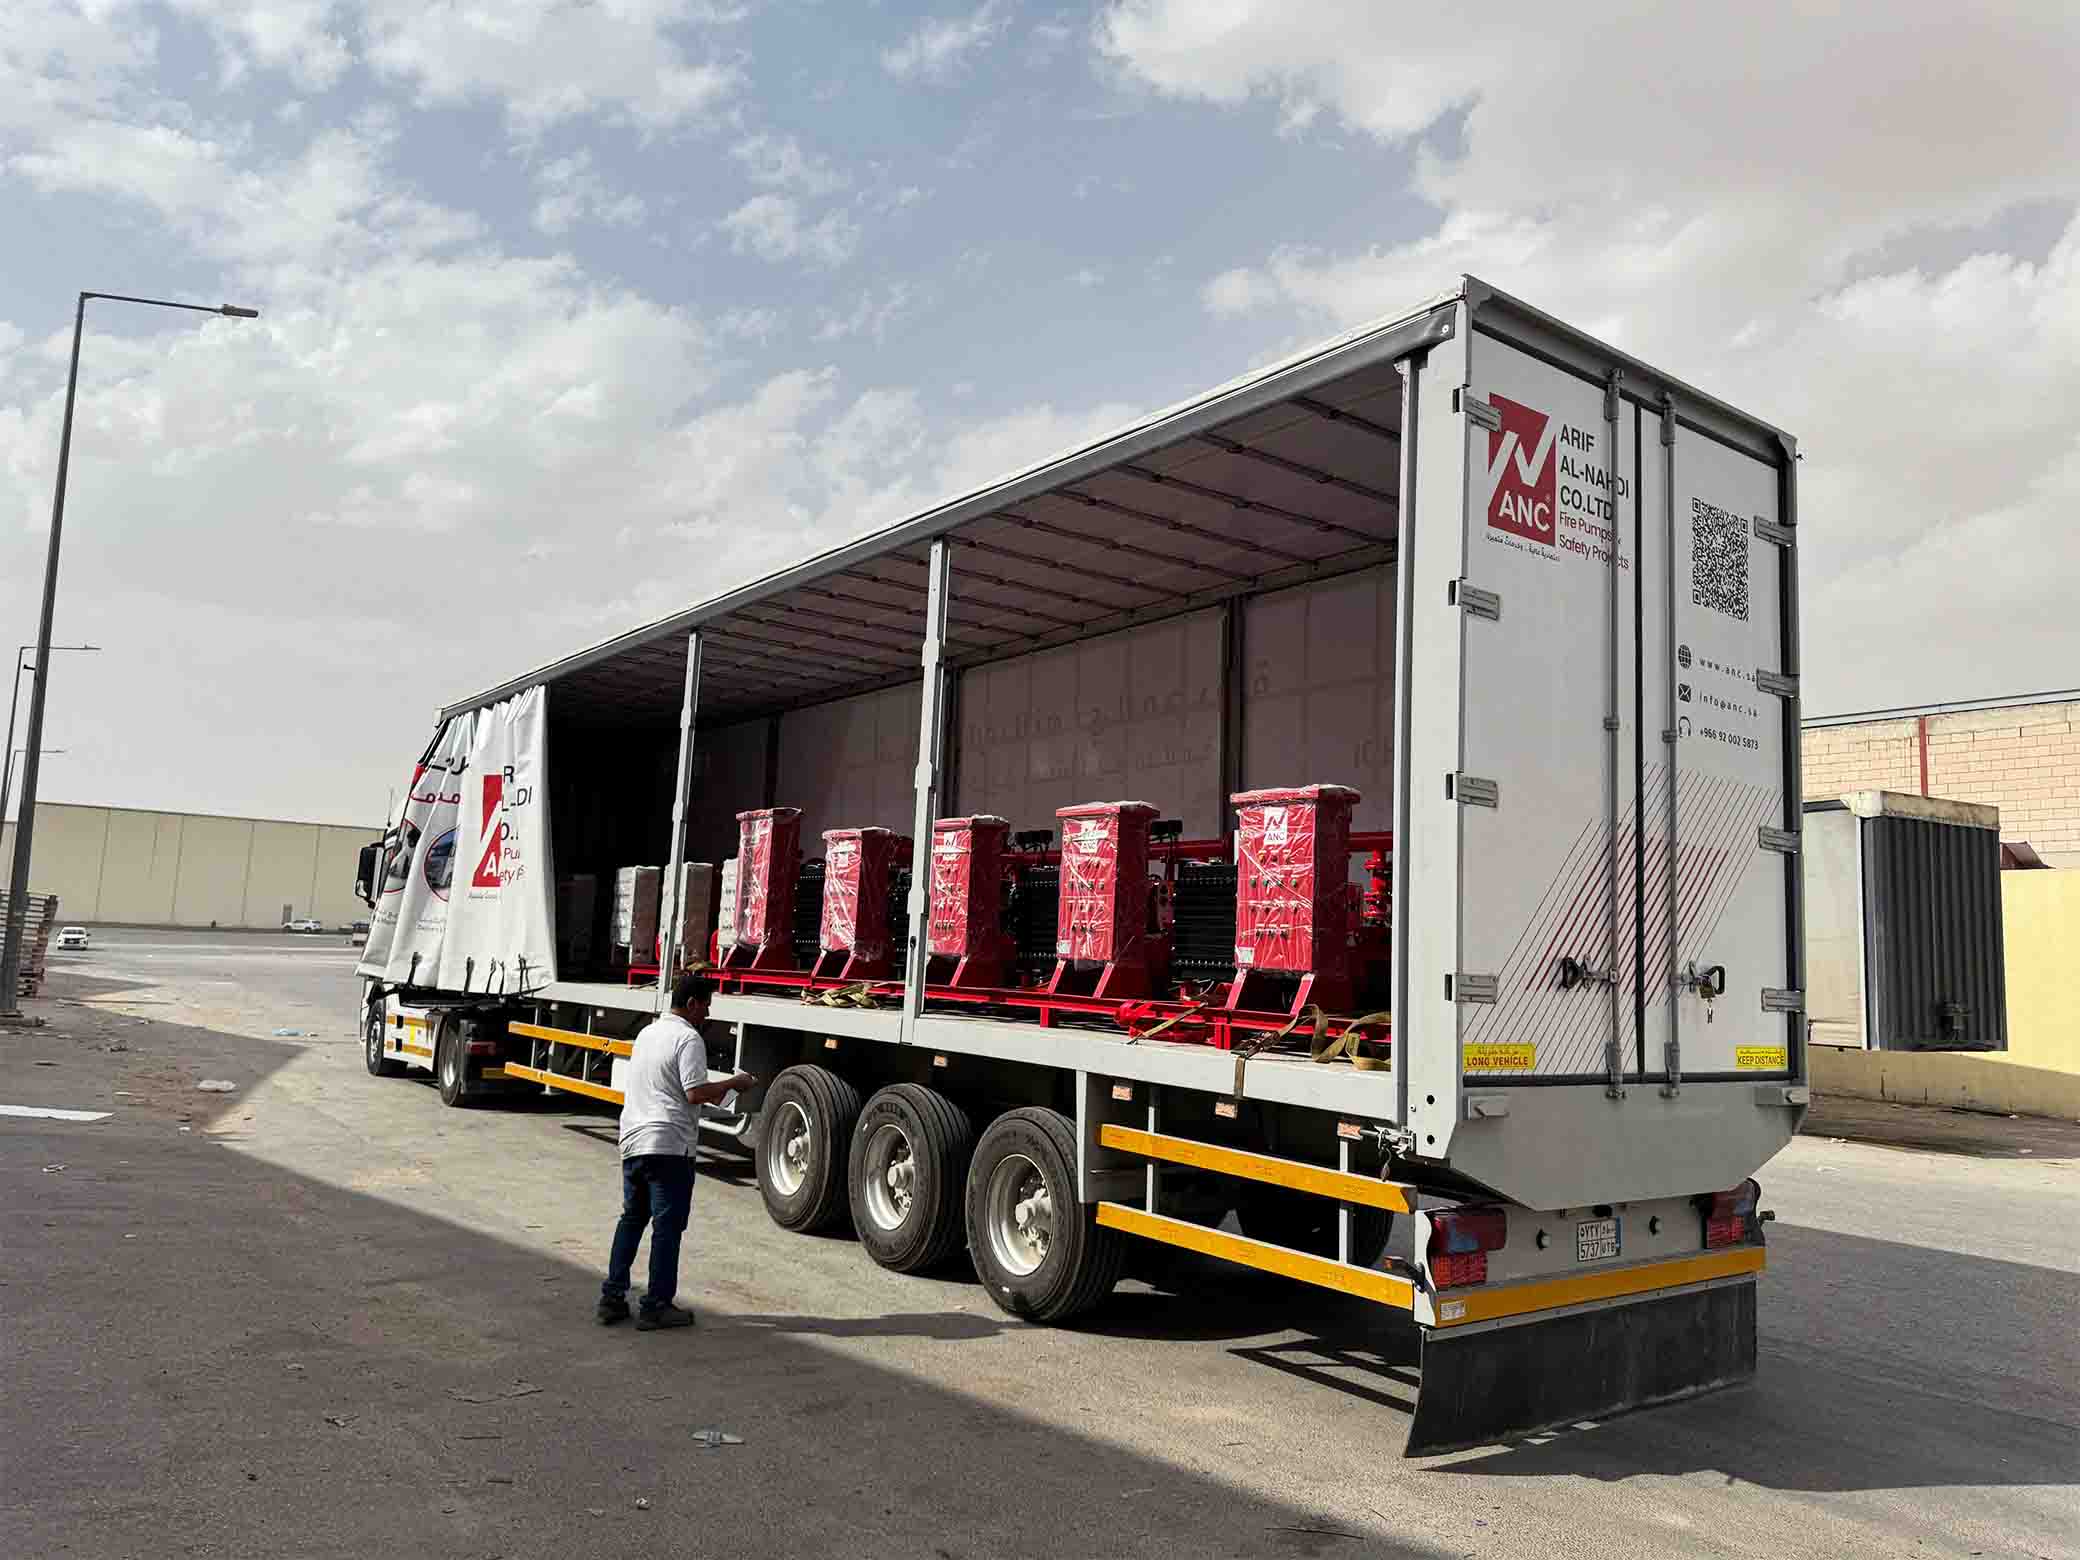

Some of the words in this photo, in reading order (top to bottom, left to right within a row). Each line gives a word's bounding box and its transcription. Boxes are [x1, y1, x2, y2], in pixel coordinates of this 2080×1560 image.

[1560, 424, 1595, 453] ARIF
[1560, 455, 1629, 499] AL-NAHDI
[1499, 490, 1551, 532] ANC
[1560, 511, 1577, 529] Fire
[1559, 534, 1592, 561] Safety
[1718, 731, 1727, 742] 92
[1728, 735, 1741, 747] 002
[1742, 738, 1759, 750] 5873
[1493, 1056, 1529, 1066] VEHICLE
[1737, 1055, 1754, 1065] KEEP
[1755, 1055, 1785, 1065] DISTANCE
[1580, 1242, 1599, 1258] 5737
